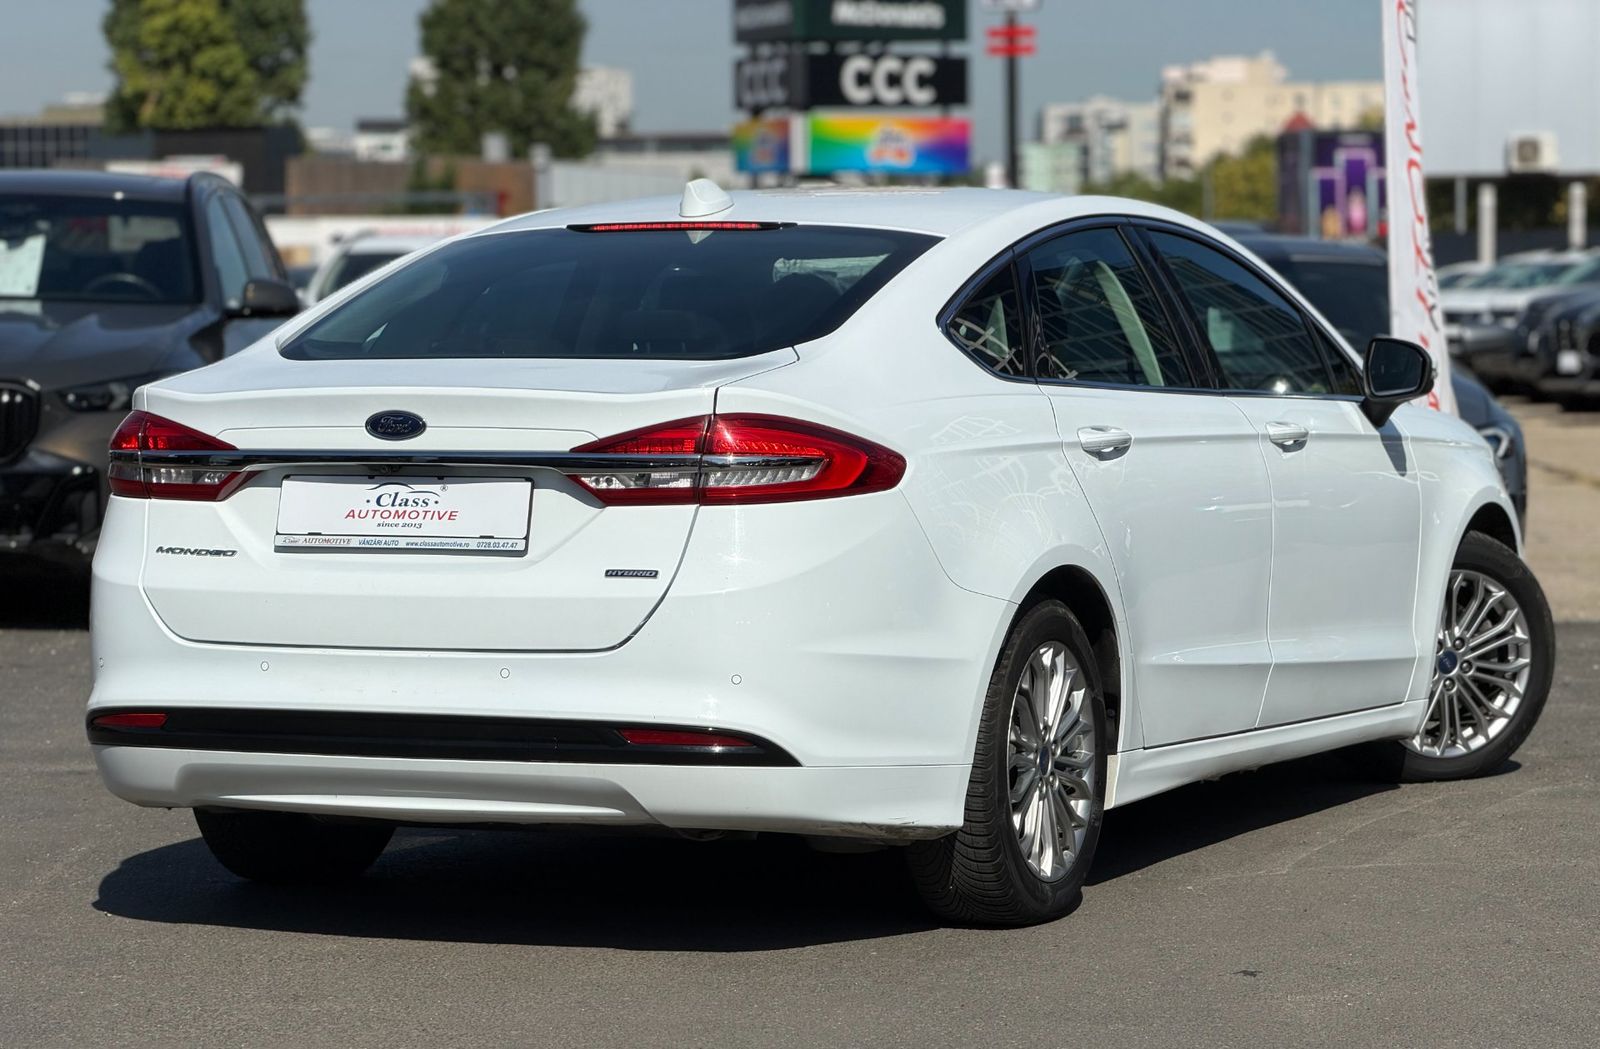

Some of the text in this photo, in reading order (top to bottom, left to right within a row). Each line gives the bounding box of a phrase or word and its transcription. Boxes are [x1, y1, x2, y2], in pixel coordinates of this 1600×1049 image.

[839, 55, 936, 105] CCC
[378, 416, 411, 432] Ford
[375, 492, 431, 508] Class
[344, 509, 460, 521] AUTOMOTIVE
[302, 537, 353, 545] AUTOMOTIVE
[384, 539, 400, 547] AUTO
[405, 540, 470, 548] www.classautomotive.ro
[476, 541, 518, 549] 0728.03.47.47
[155, 546, 238, 557] MONDEO
[606, 569, 657, 577] HYBRID
